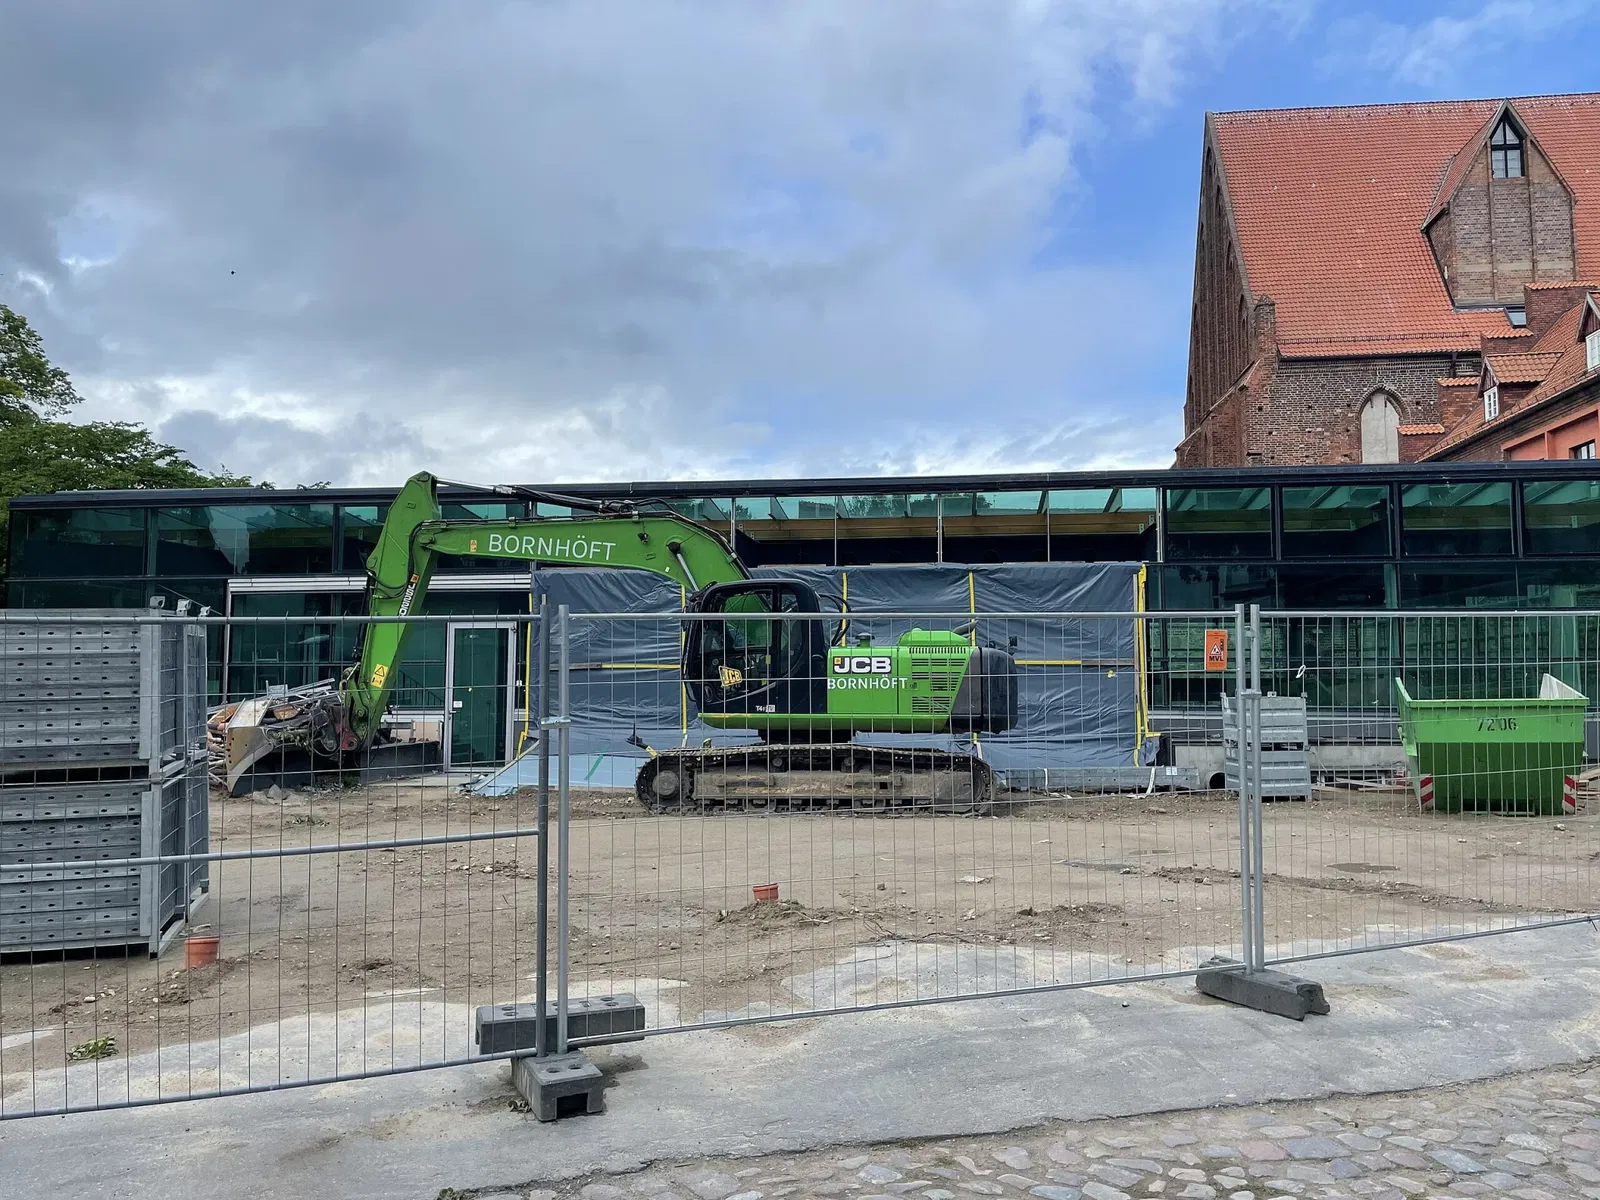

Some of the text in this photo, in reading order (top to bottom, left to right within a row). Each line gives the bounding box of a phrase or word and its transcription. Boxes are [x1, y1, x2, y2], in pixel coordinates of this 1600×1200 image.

[488, 533, 617, 561] BORNHÖFT
[833, 656, 892, 674] JCB
[722, 668, 741, 685] JCB
[827, 674, 908, 690] BORNHÖFT
